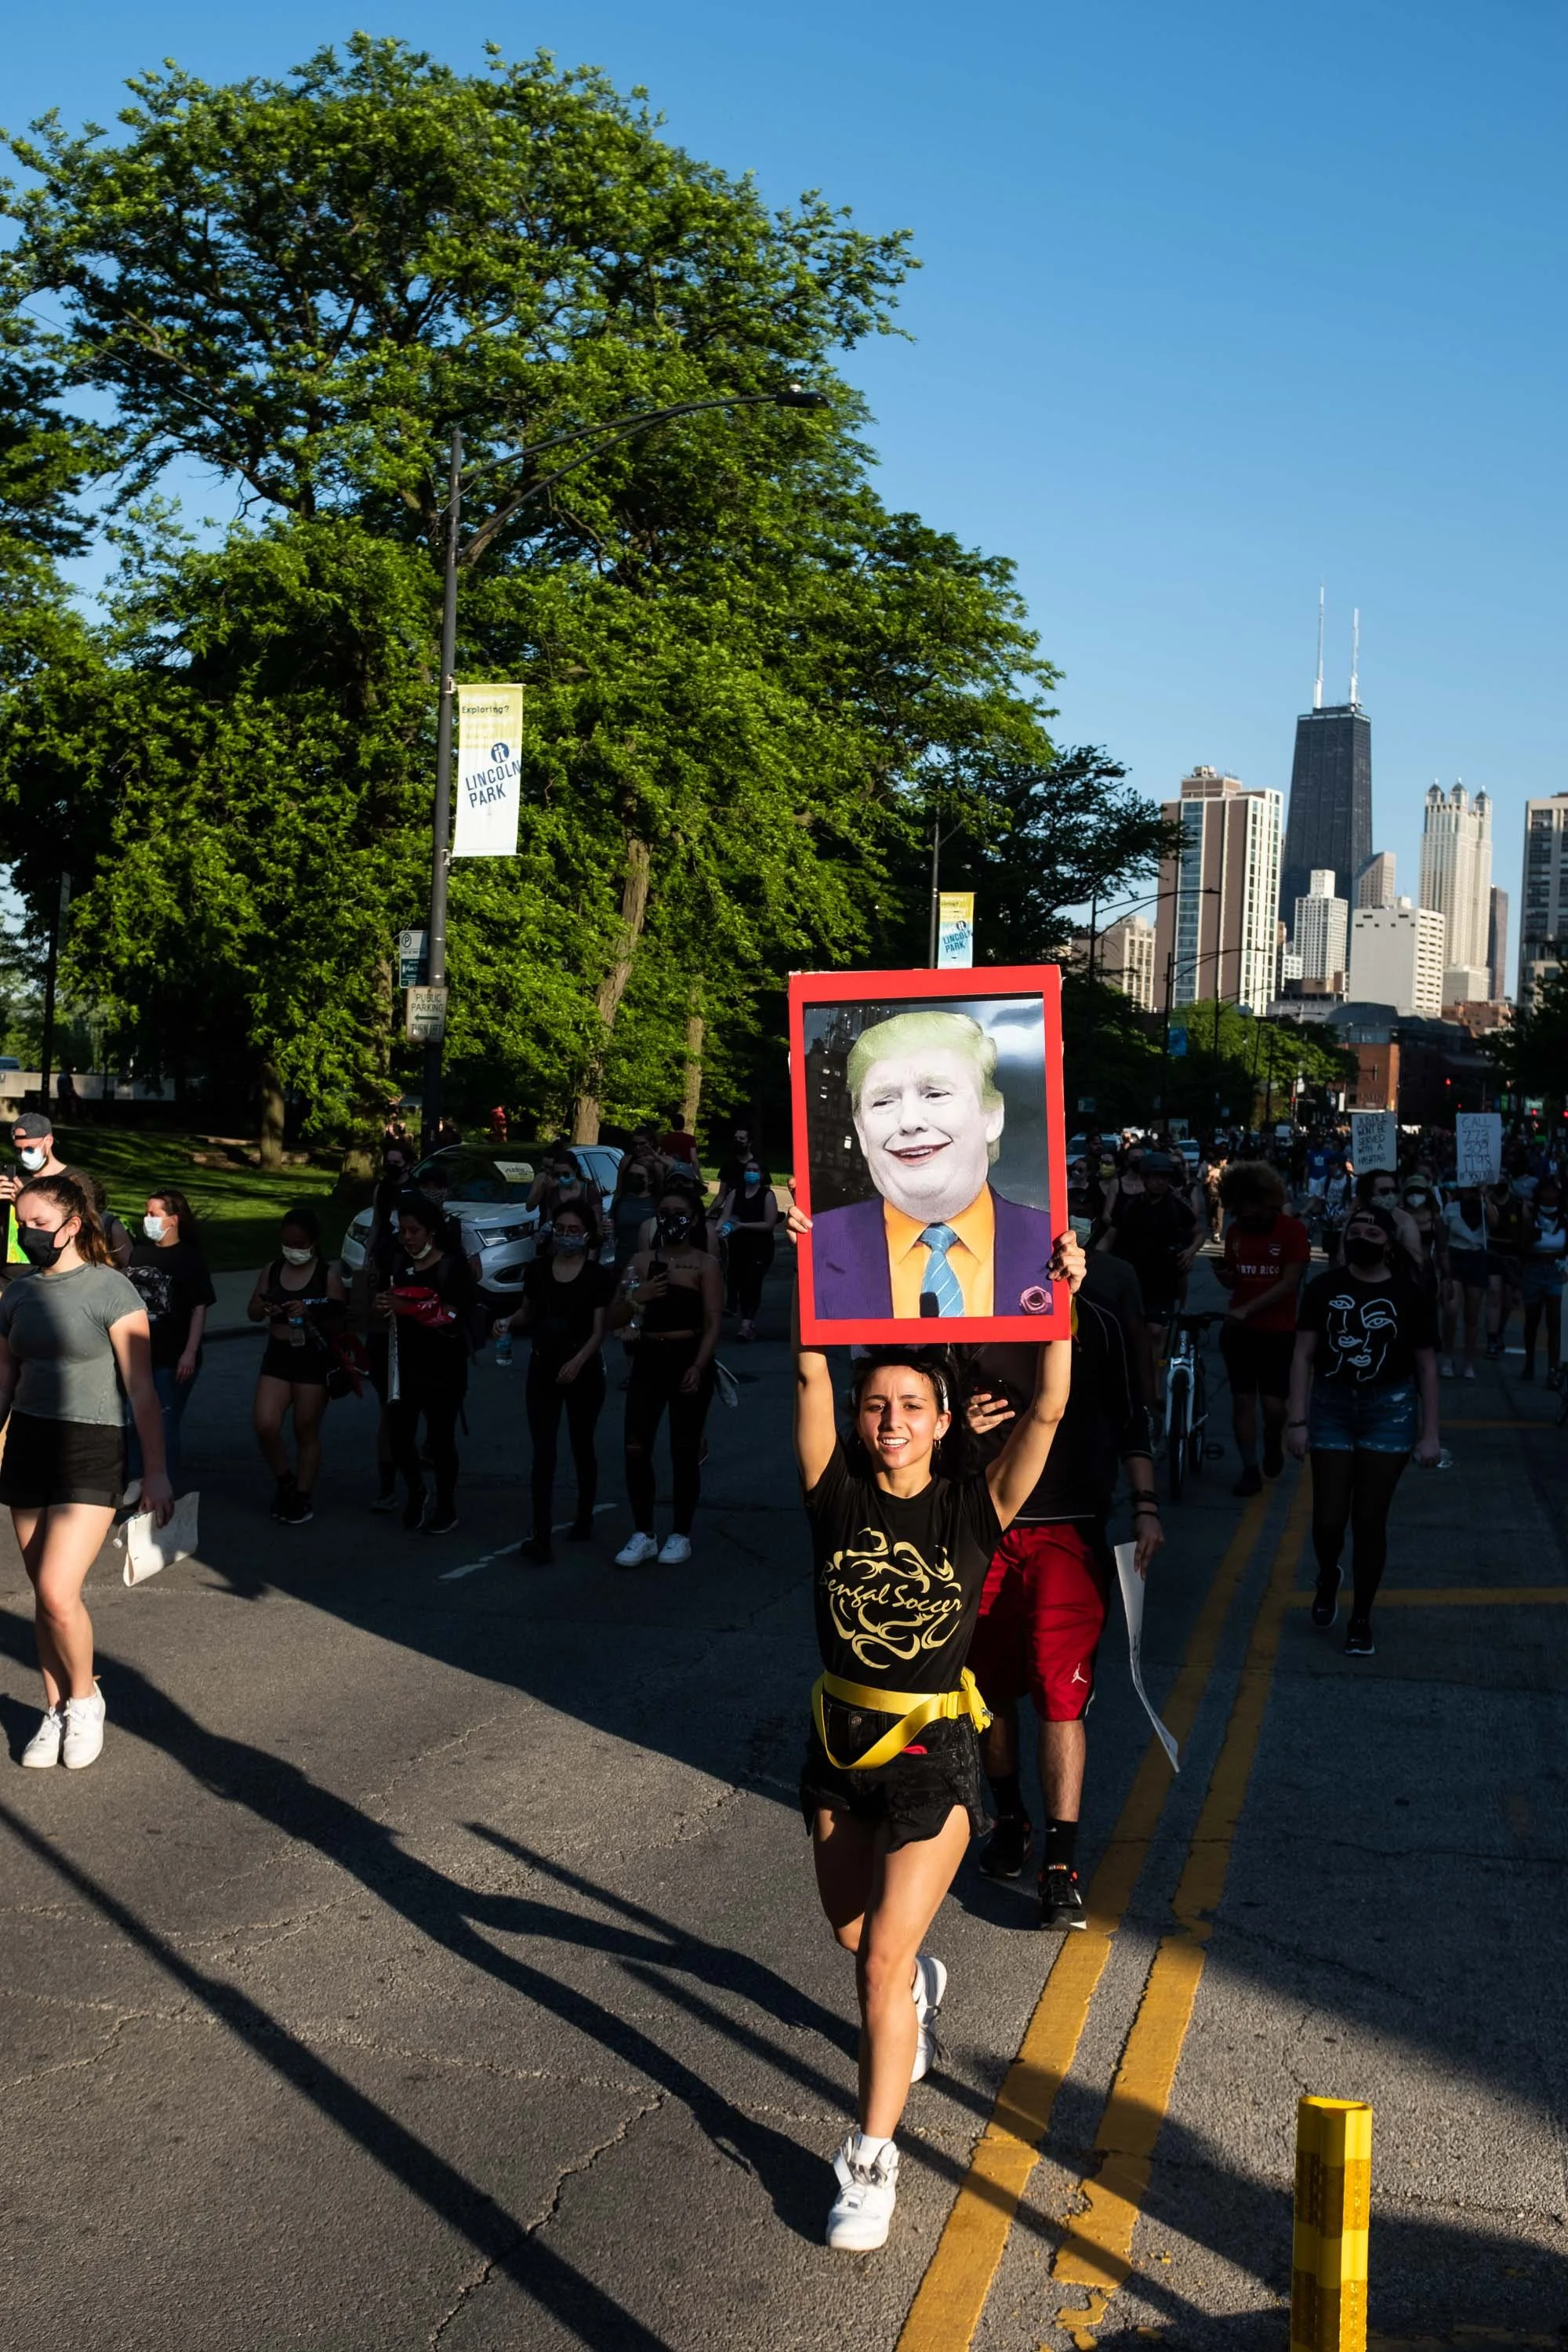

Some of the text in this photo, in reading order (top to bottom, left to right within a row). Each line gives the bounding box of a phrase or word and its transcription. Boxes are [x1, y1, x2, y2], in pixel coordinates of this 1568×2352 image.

[461, 705, 510, 715] Exploring?
[465, 759, 521, 791] LINCOLN
[469, 782, 506, 808] PARK
[945, 940, 966, 953] PARK
[416, 993, 441, 1003] PUBLIC
[411, 1004, 444, 1013] PARKING
[1377, 1122, 1386, 1134] BE
[1461, 1116, 1494, 1129] CALL
[1358, 1134, 1386, 1145] SERVED
[1358, 1145, 1373, 1155] WITH
[1259, 1264, 1280, 1275] RICO
[818, 1560, 964, 1613] Bengal Soccer
